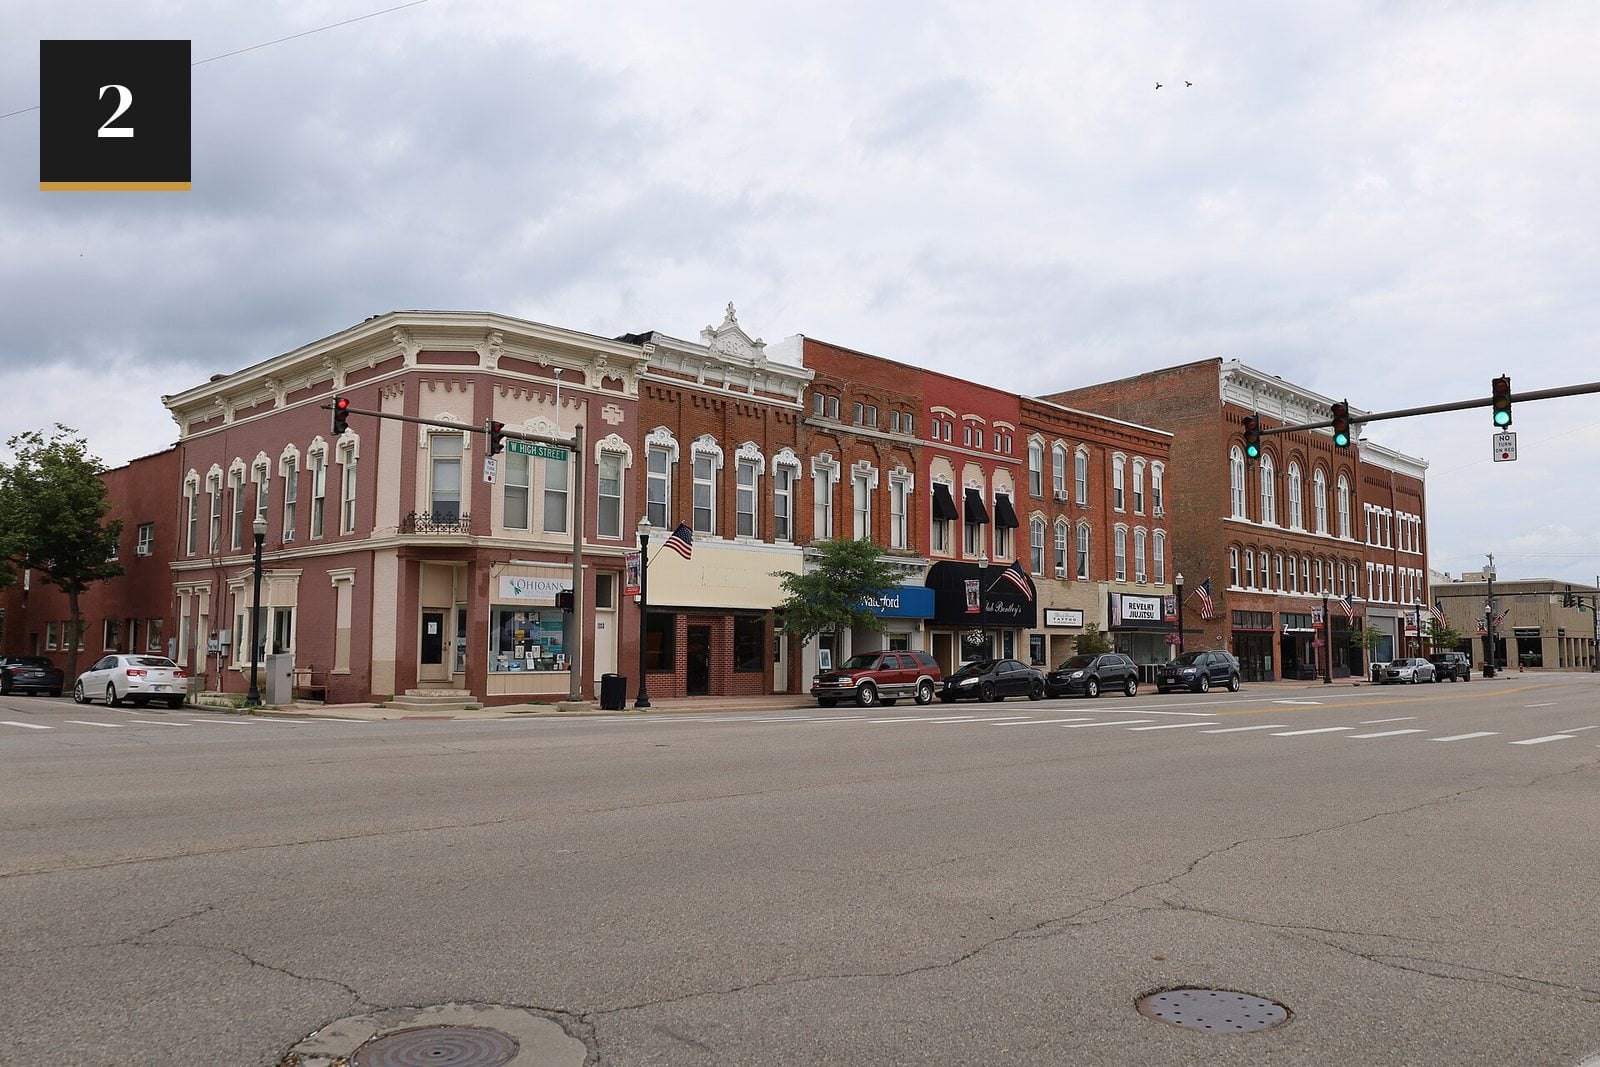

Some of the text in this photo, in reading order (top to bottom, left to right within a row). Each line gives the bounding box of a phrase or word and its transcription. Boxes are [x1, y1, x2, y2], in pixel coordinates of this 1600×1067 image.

[510, 441, 566, 460] W HIGH STREET
[516, 578, 564, 592] OHIOANS
[1128, 602, 1155, 611] REVELRY
